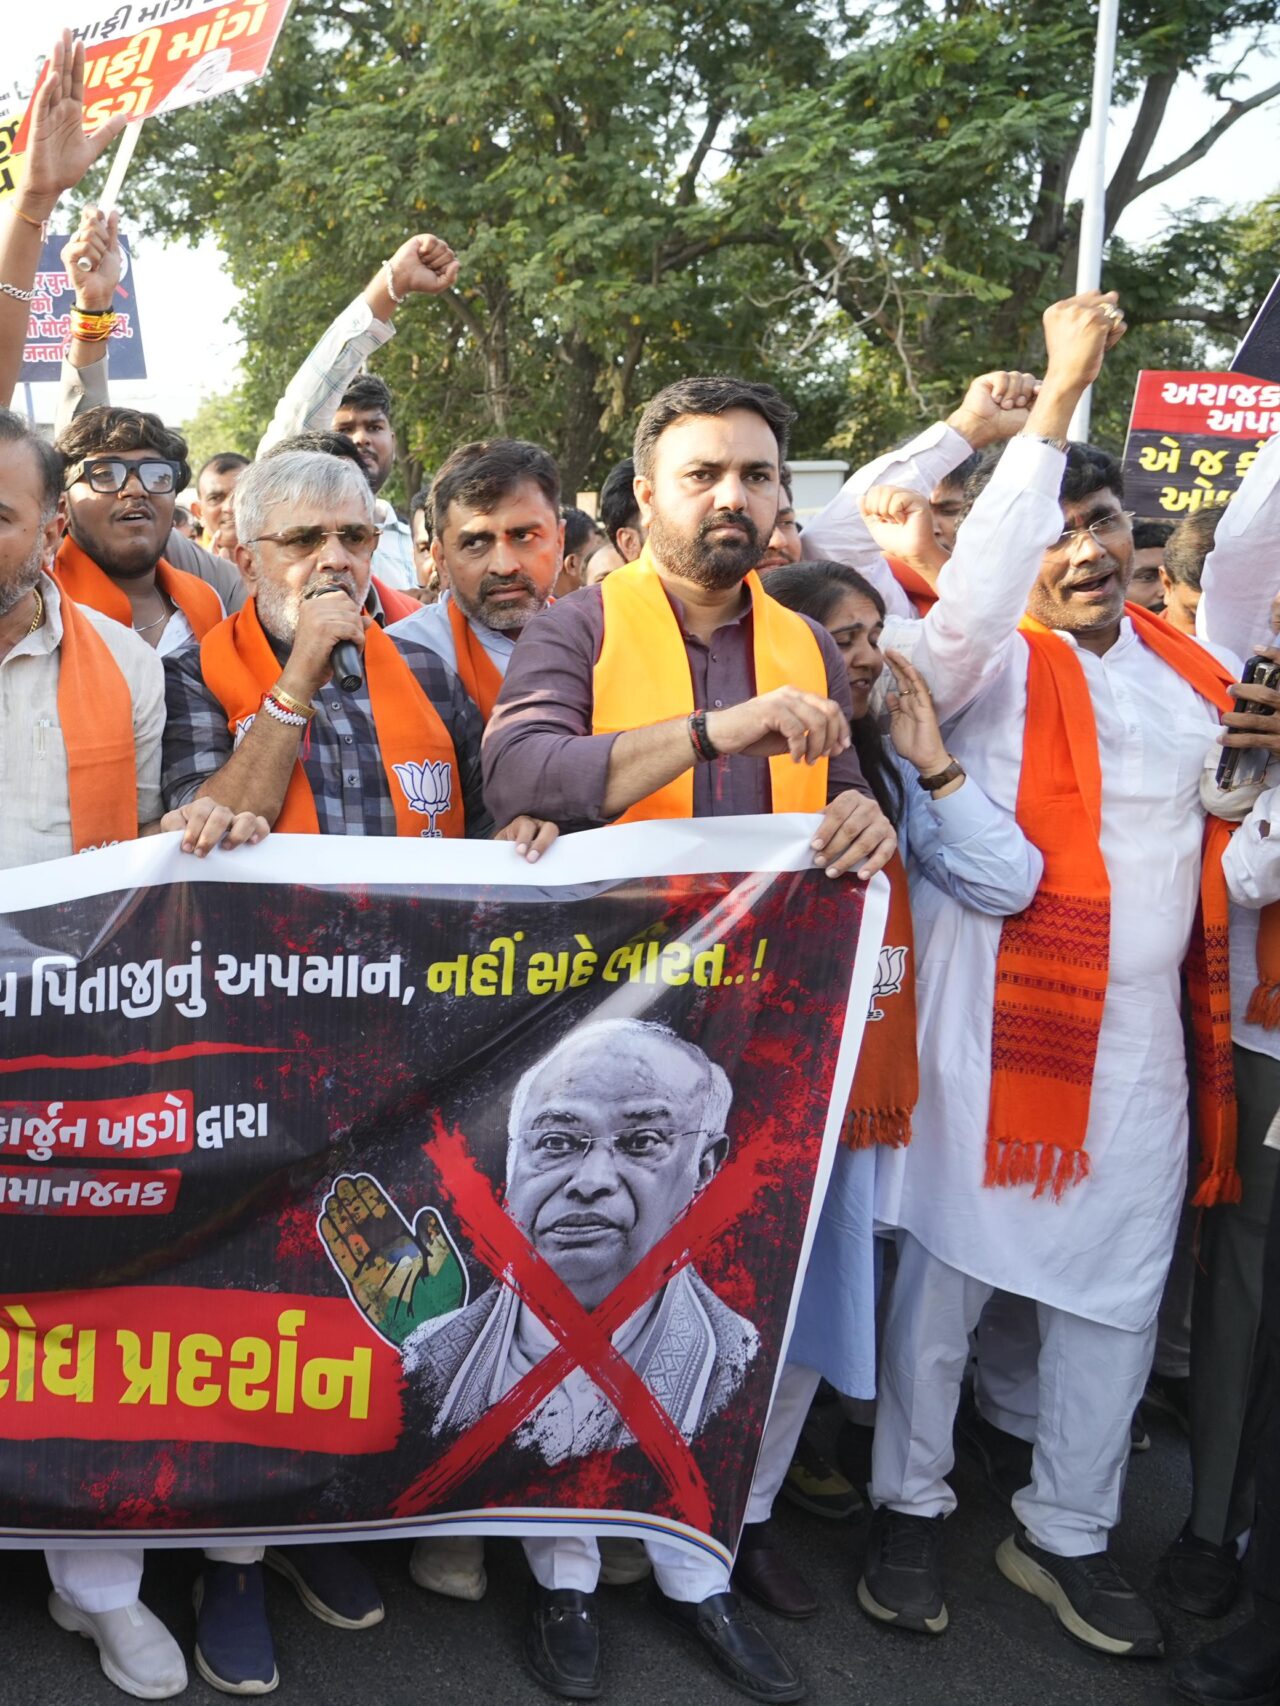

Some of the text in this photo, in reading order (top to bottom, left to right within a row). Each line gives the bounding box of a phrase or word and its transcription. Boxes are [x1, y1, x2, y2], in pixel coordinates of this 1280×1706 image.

[1139, 436, 1181, 473] એ
[1190, 449, 1230, 476] જ
[31, 940, 207, 1019] પિતાજીનું
[214, 952, 416, 1005] અપમાન,
[427, 930, 526, 997] નહીં
[527, 933, 601, 995] સહે
[97, 1093, 187, 1148] ખડગે
[196, 1103, 268, 1149] દ્વારા
[117, 1309, 372, 1419] પ્રદર્શન
